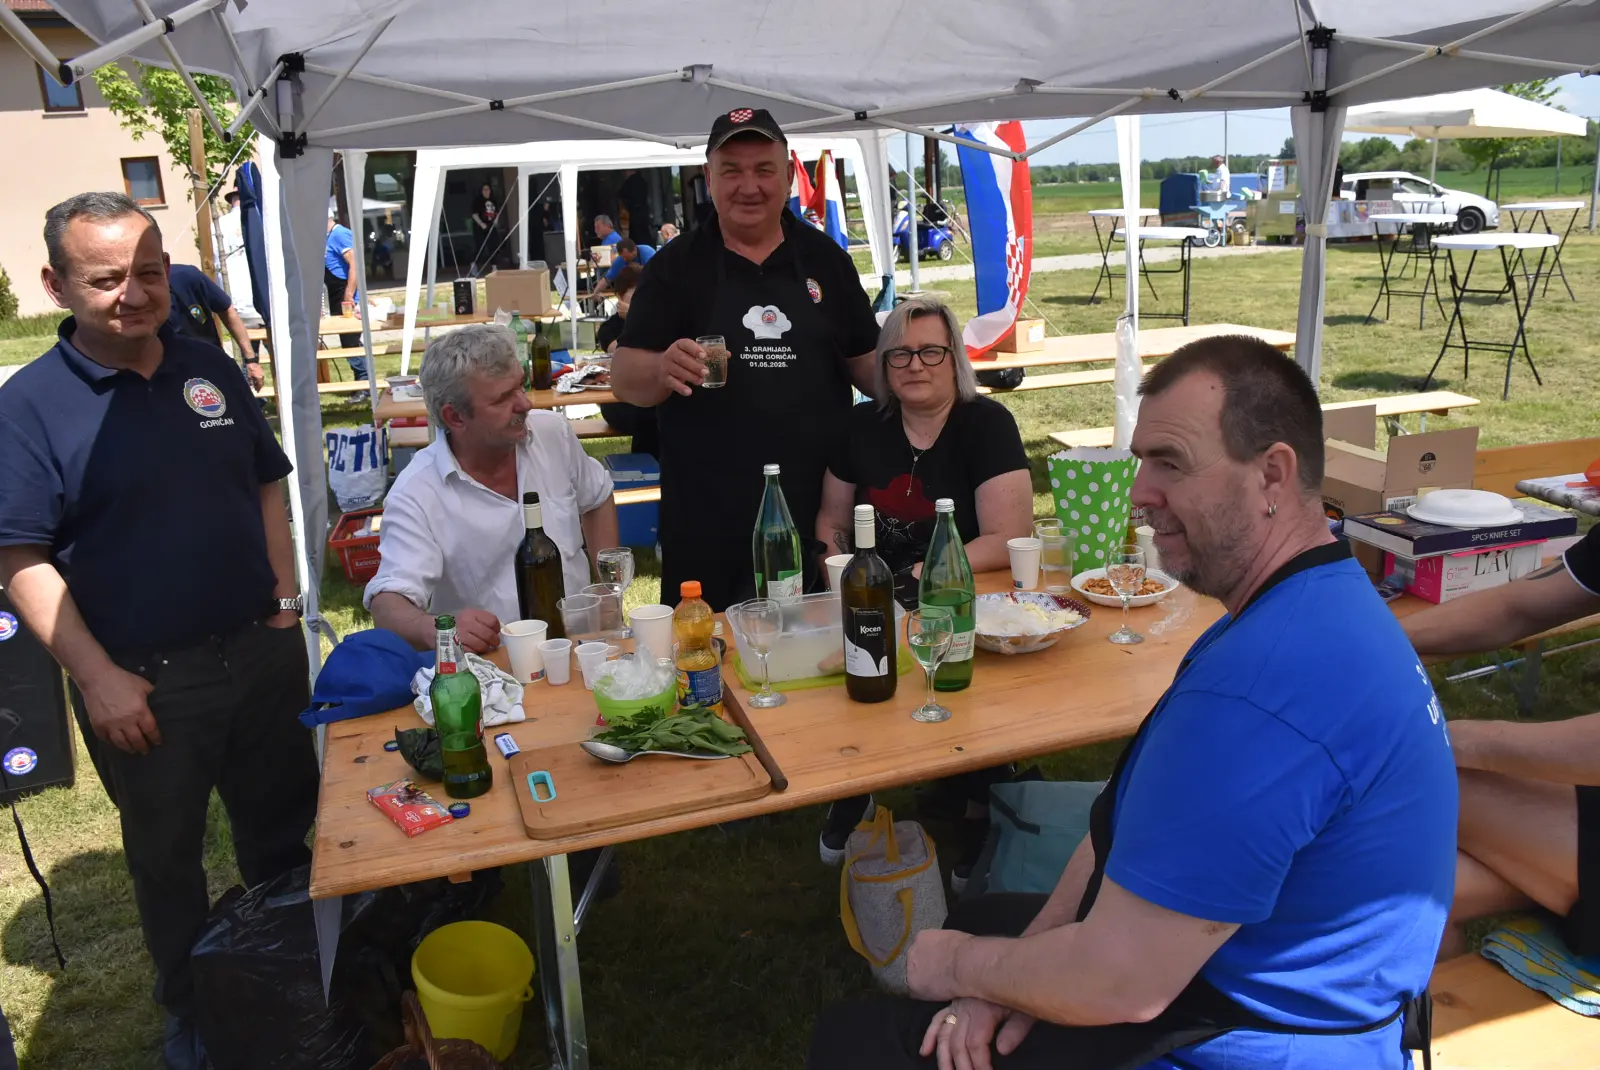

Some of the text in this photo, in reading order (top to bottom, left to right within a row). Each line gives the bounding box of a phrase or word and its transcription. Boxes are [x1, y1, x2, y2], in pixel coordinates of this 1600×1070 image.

[200, 417, 235, 429] GORIČAN
[1489, 530, 1509, 540] KNIFE
[1509, 528, 1522, 538] SET
[860, 625, 882, 635] Kocen
